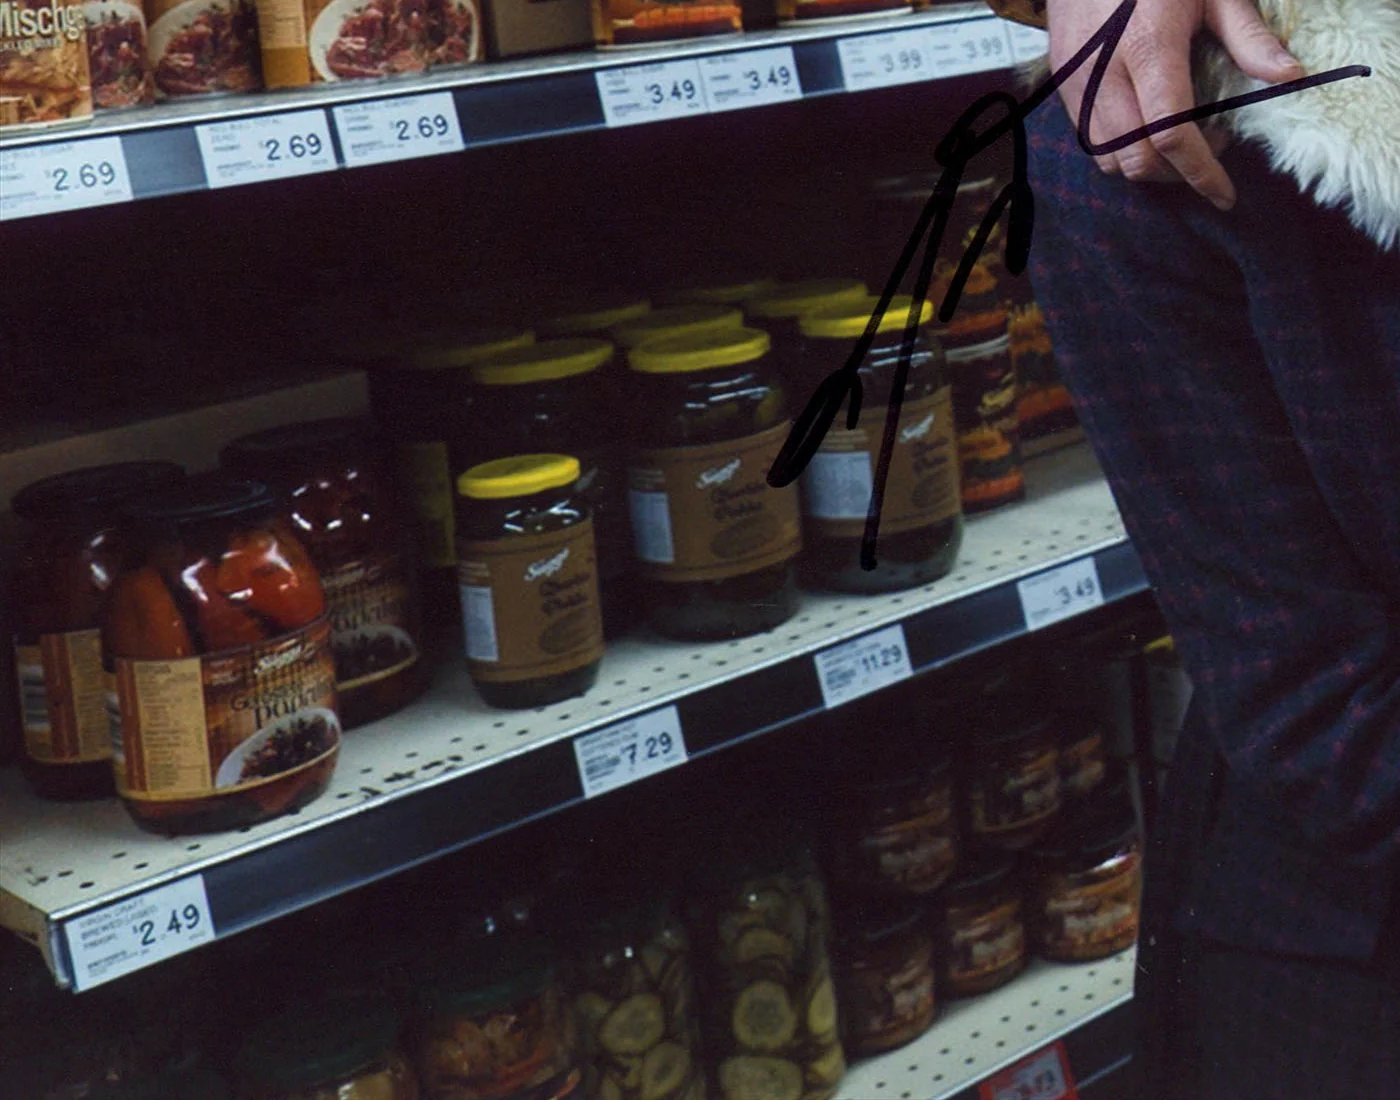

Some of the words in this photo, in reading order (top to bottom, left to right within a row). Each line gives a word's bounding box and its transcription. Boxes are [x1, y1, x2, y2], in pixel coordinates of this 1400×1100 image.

[648, 80, 696, 104] 3.49
[747, 67, 791, 91] 3.49
[395, 113, 449, 141] 2.69
[264, 133, 322, 162] 2.69
[52, 161, 116, 192] 2.69
[625, 731, 673, 765] 7.29
[139, 903, 200, 946] 2.49
